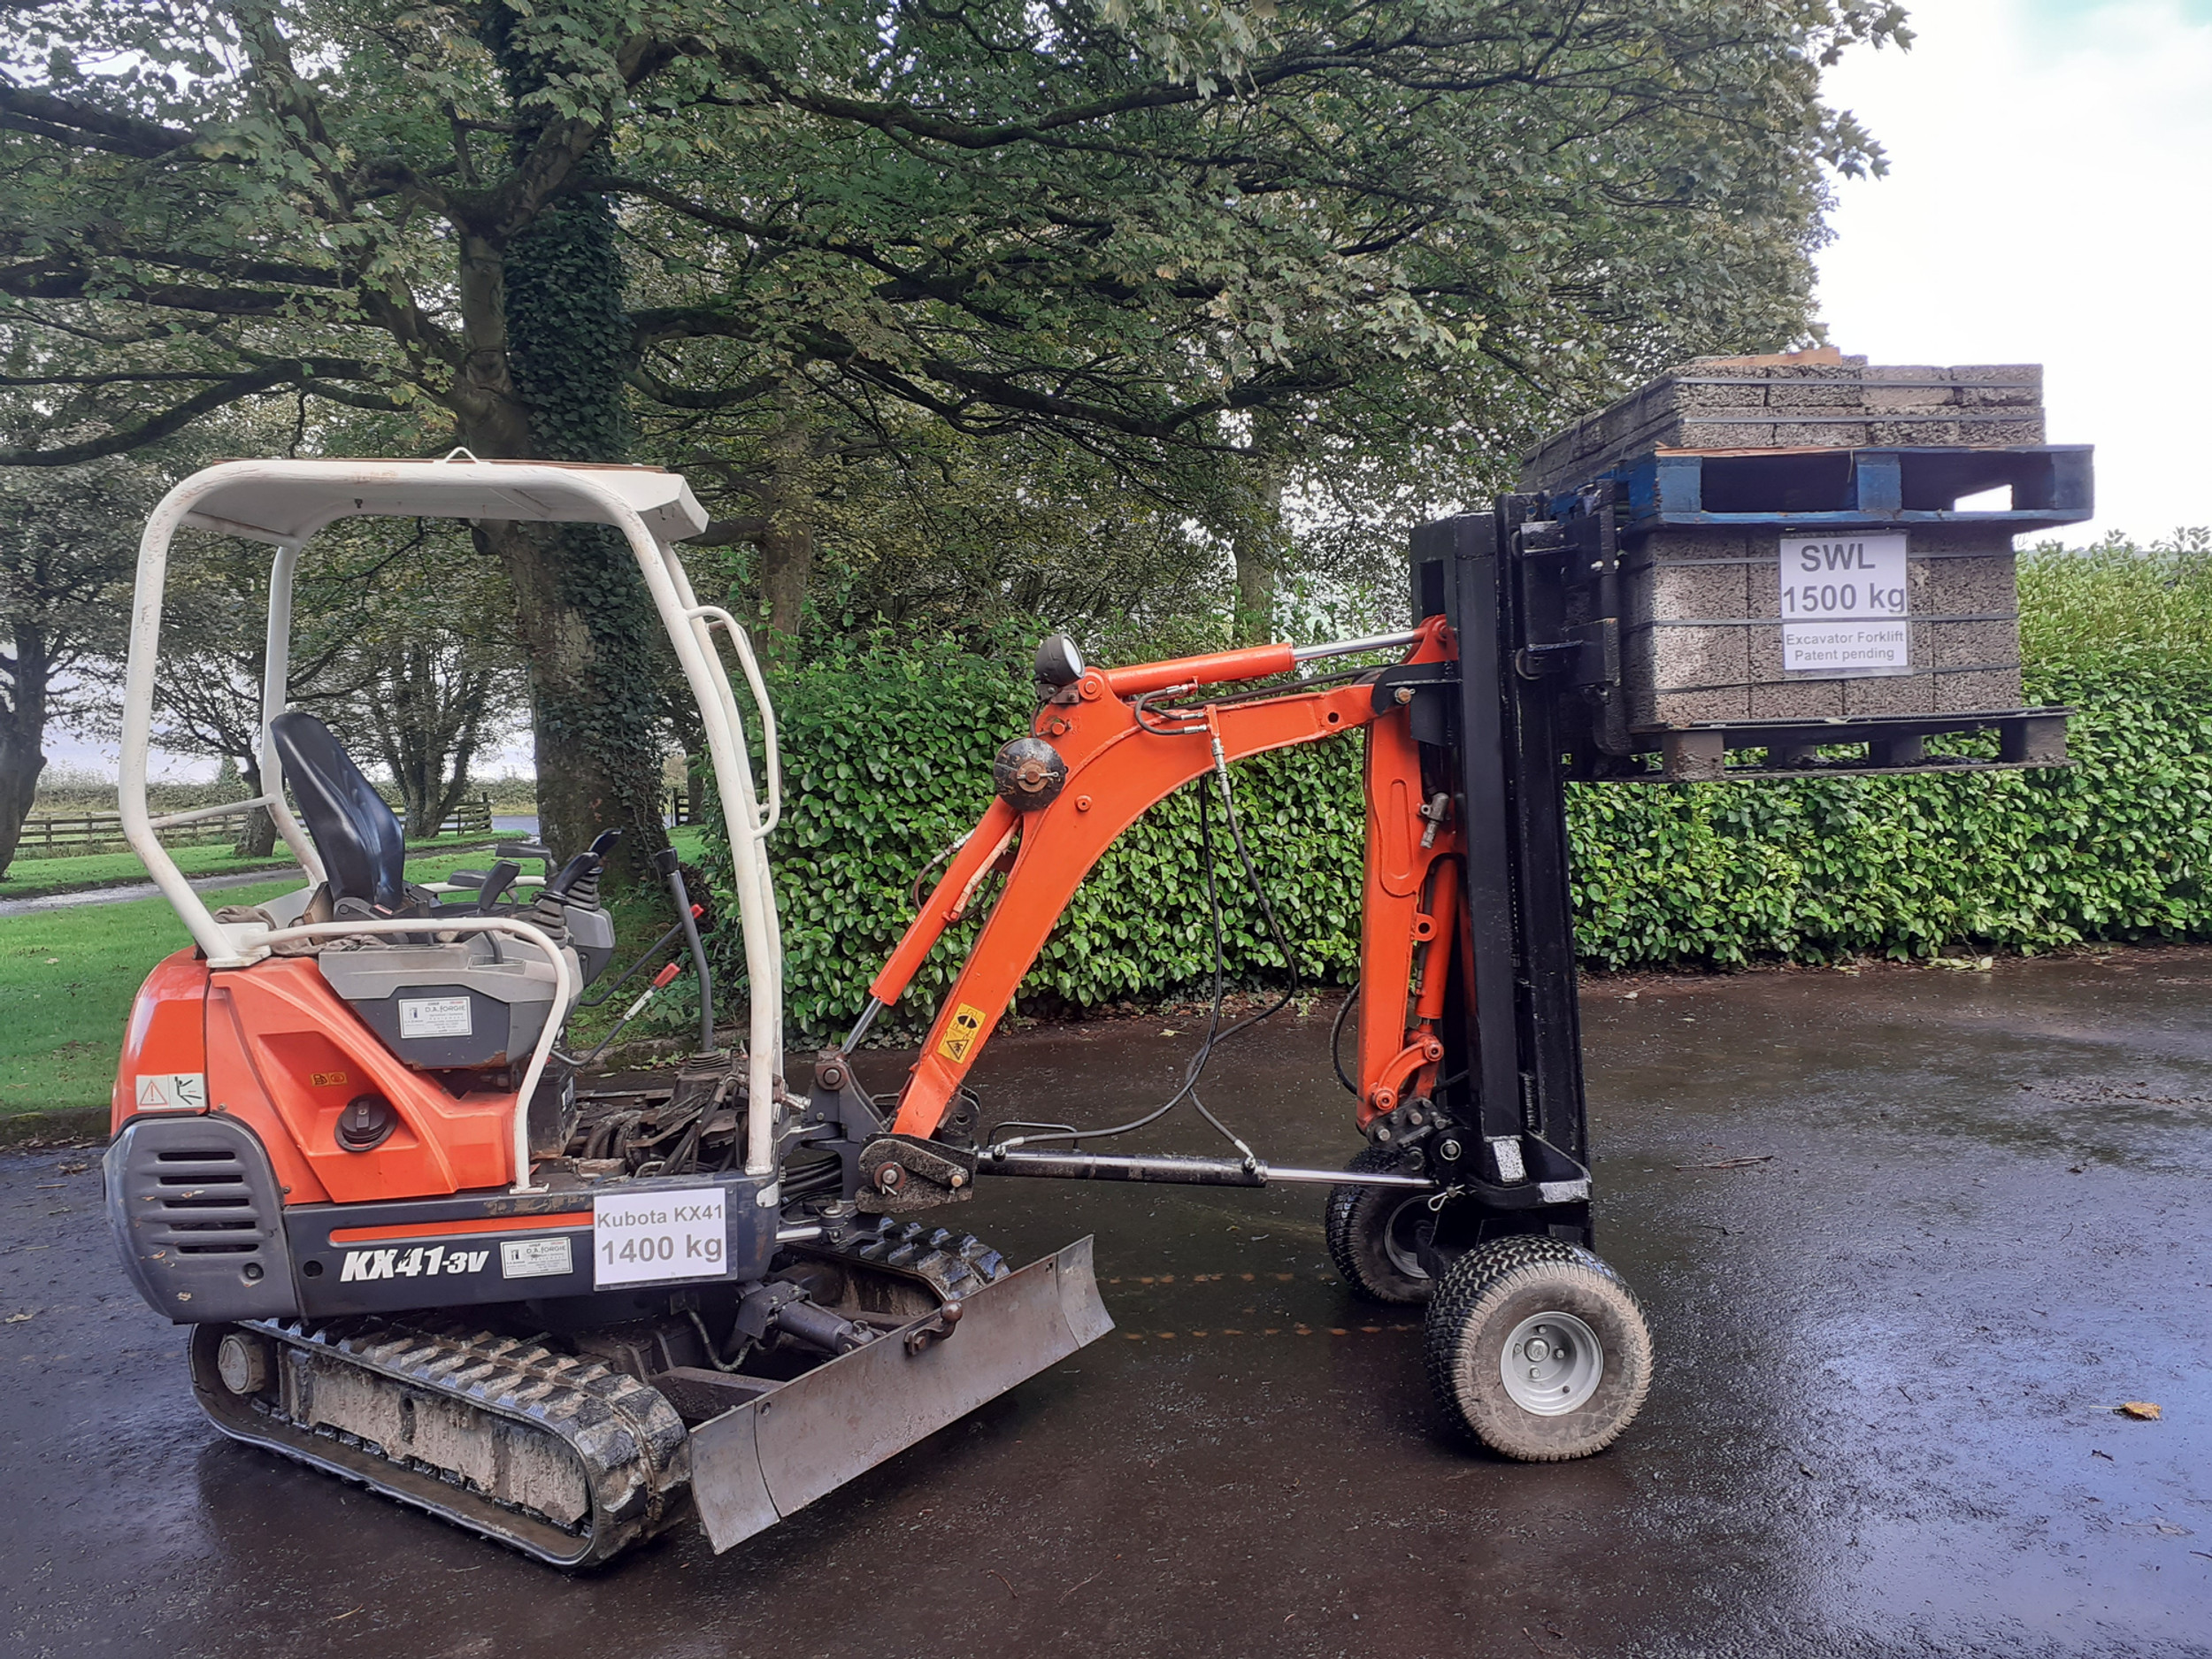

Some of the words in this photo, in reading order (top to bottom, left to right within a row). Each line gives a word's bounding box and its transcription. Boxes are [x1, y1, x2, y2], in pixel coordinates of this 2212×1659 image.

[1800, 542, 1876, 572] SWL
[1783, 583, 1857, 612] 1500
[1869, 582, 1905, 614] kg
[1786, 633, 1854, 646] Excavator
[1857, 630, 1904, 643] Forklift
[1794, 648, 1839, 661] Patent
[1842, 647, 1894, 662] pending
[596, 1209, 667, 1229] Kubota
[674, 1203, 723, 1223] KX41
[340, 1245, 489, 1282] KX41-3V
[601, 1235, 674, 1265] 1400
[686, 1233, 723, 1263] kg
